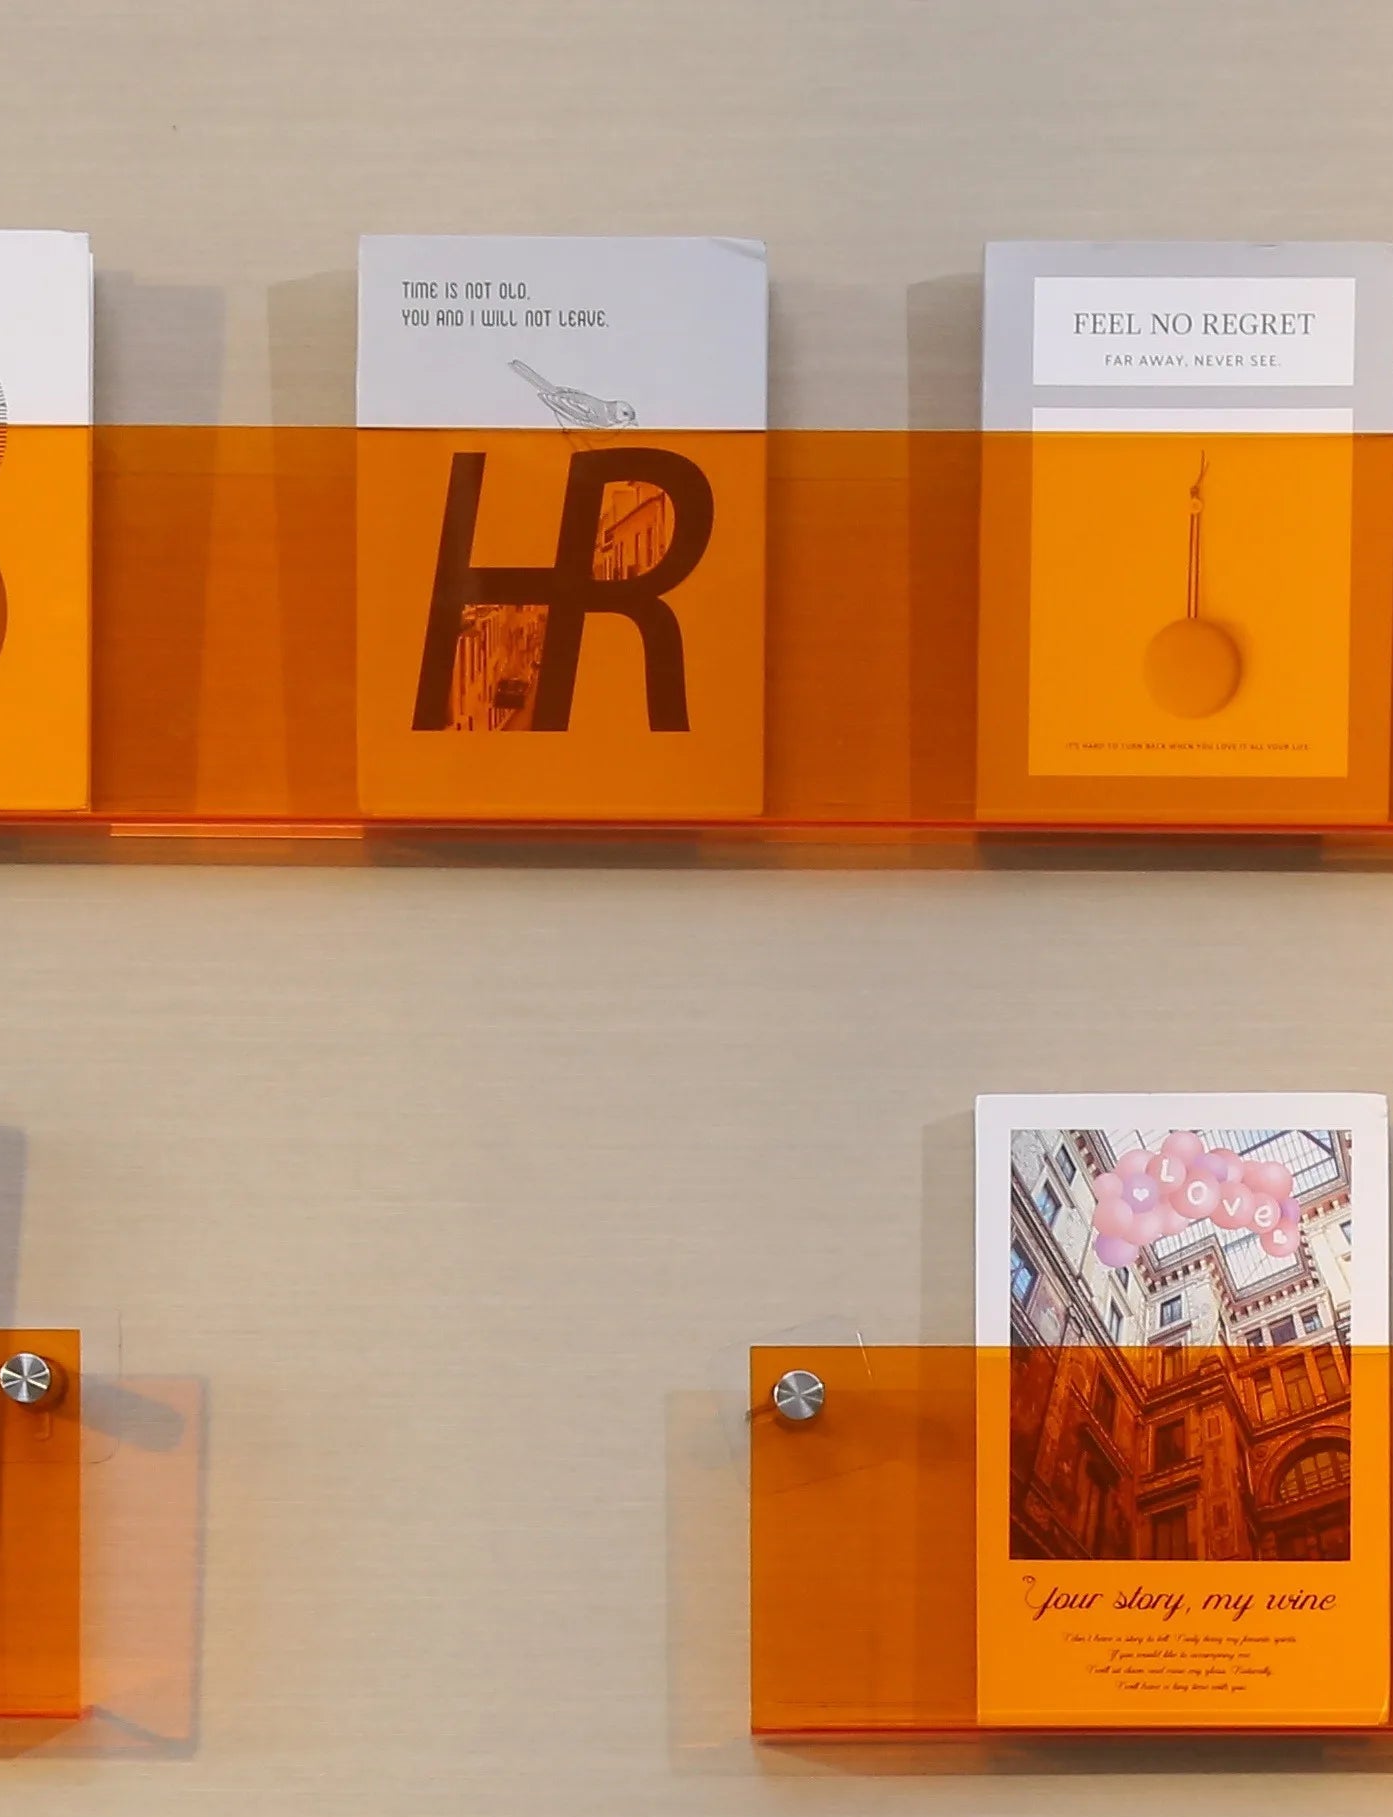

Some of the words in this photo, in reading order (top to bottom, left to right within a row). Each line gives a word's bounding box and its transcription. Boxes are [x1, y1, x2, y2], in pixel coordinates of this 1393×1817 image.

[402, 281, 438, 299] TIME
[445, 282, 458, 299] IS
[465, 282, 492, 300] NOT
[499, 282, 530, 300] OLD.
[402, 309, 429, 327] YOU
[436, 309, 464, 327] AND
[470, 310, 475, 327] I
[481, 310, 518, 327] WILL
[525, 310, 552, 327] NOT
[559, 310, 609, 328] LEAVE.
[1073, 312, 1141, 335] FEEL
[1150, 313, 1193, 336] NO
[1202, 313, 1316, 336] REGRET
[1105, 354, 1133, 367] FAR
[1139, 354, 1188, 368] AWAY,
[1194, 355, 1244, 367] NEVER
[1250, 355, 1281, 367] SEE.
[1022, 1576, 1103, 1621] Your
[1113, 1586, 1192, 1621] story,
[1202, 1592, 1255, 1621] my
[1266, 1589, 1337, 1610] wine
